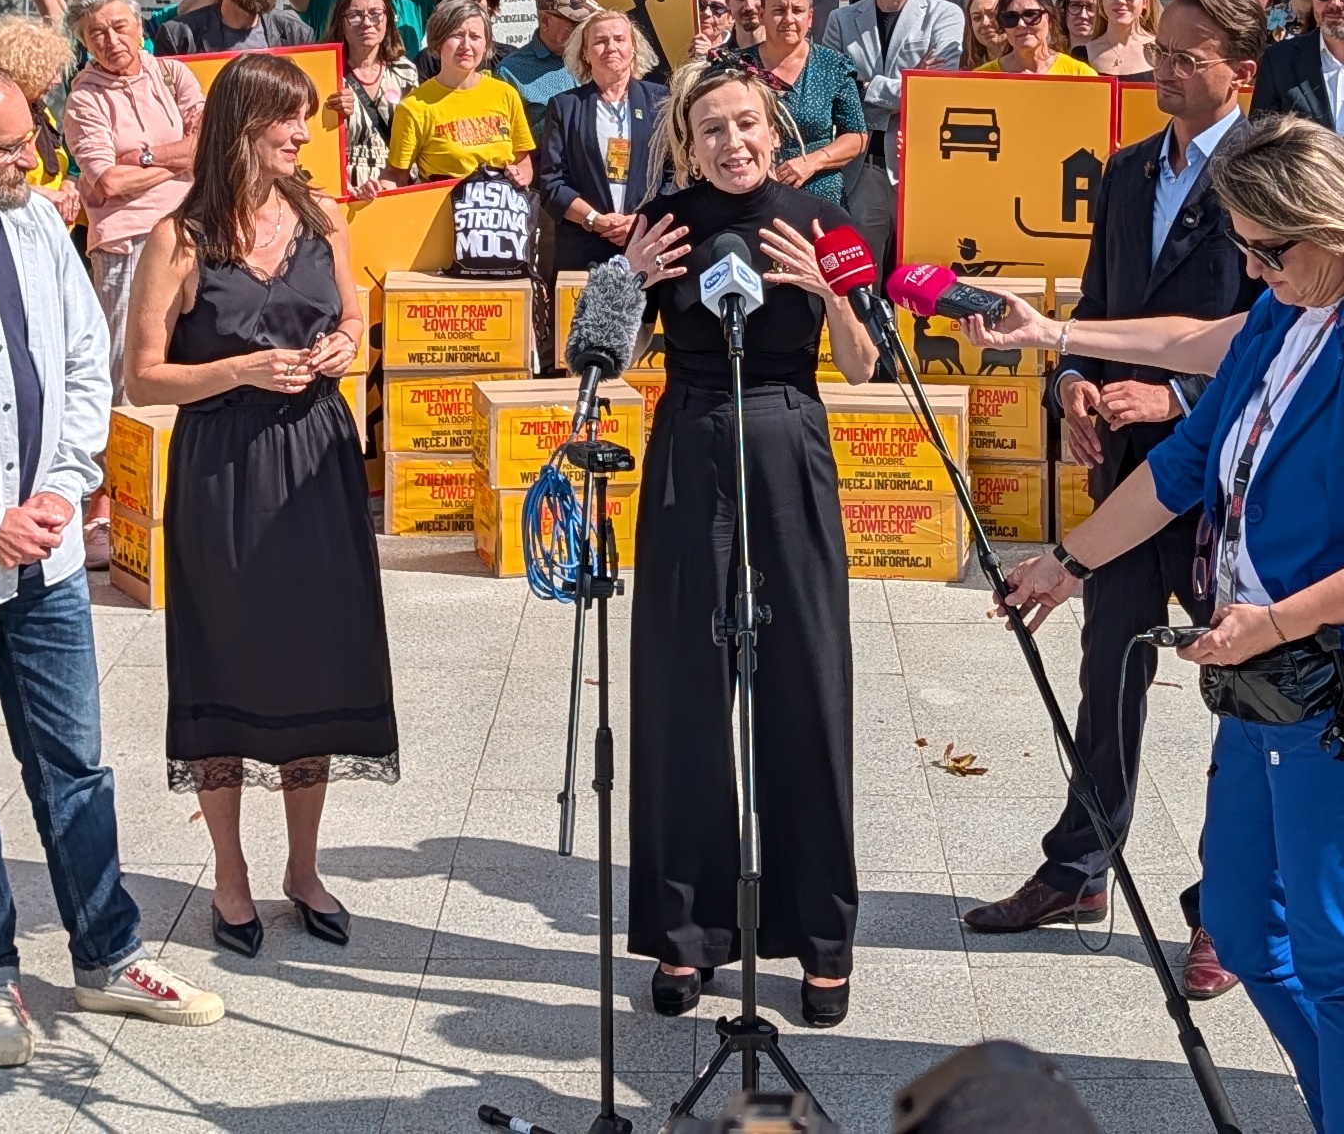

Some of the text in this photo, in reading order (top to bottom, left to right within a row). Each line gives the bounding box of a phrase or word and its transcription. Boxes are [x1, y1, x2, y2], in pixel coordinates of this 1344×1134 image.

[454, 181, 529, 213] JASNA
[454, 208, 528, 236] STRONA
[455, 229, 528, 261] MOCY
[406, 301, 503, 318] ZMIEŃMY PRAWO
[422, 318, 487, 331] ŁOWIECKIE
[408, 352, 500, 365] WIĘCEJ INFORMACJI
[410, 384, 462, 403] ZMIEŃMY
[976, 389, 1018, 404] PRAWO
[426, 402, 472, 416] ŁOWIEC
[969, 403, 1002, 417] ECKIE
[833, 424, 888, 441] ZMIEŃMY
[412, 436, 447, 450] WIĘCEJ
[850, 441, 918, 457] ŁOWIECKIE
[969, 437, 1016, 449] FORMACJI
[414, 469, 466, 486] ZMIEŃMY
[874, 478, 933, 491] INFORMACJI
[977, 477, 1019, 492] PRAWO
[430, 486, 475, 499] ŁOWIEC
[840, 500, 932, 520] MIEŃMY PRAWO
[849, 519, 916, 534] ŁOWIECKIE
[847, 556, 932, 569] ĘCEJ INFORMACJI
